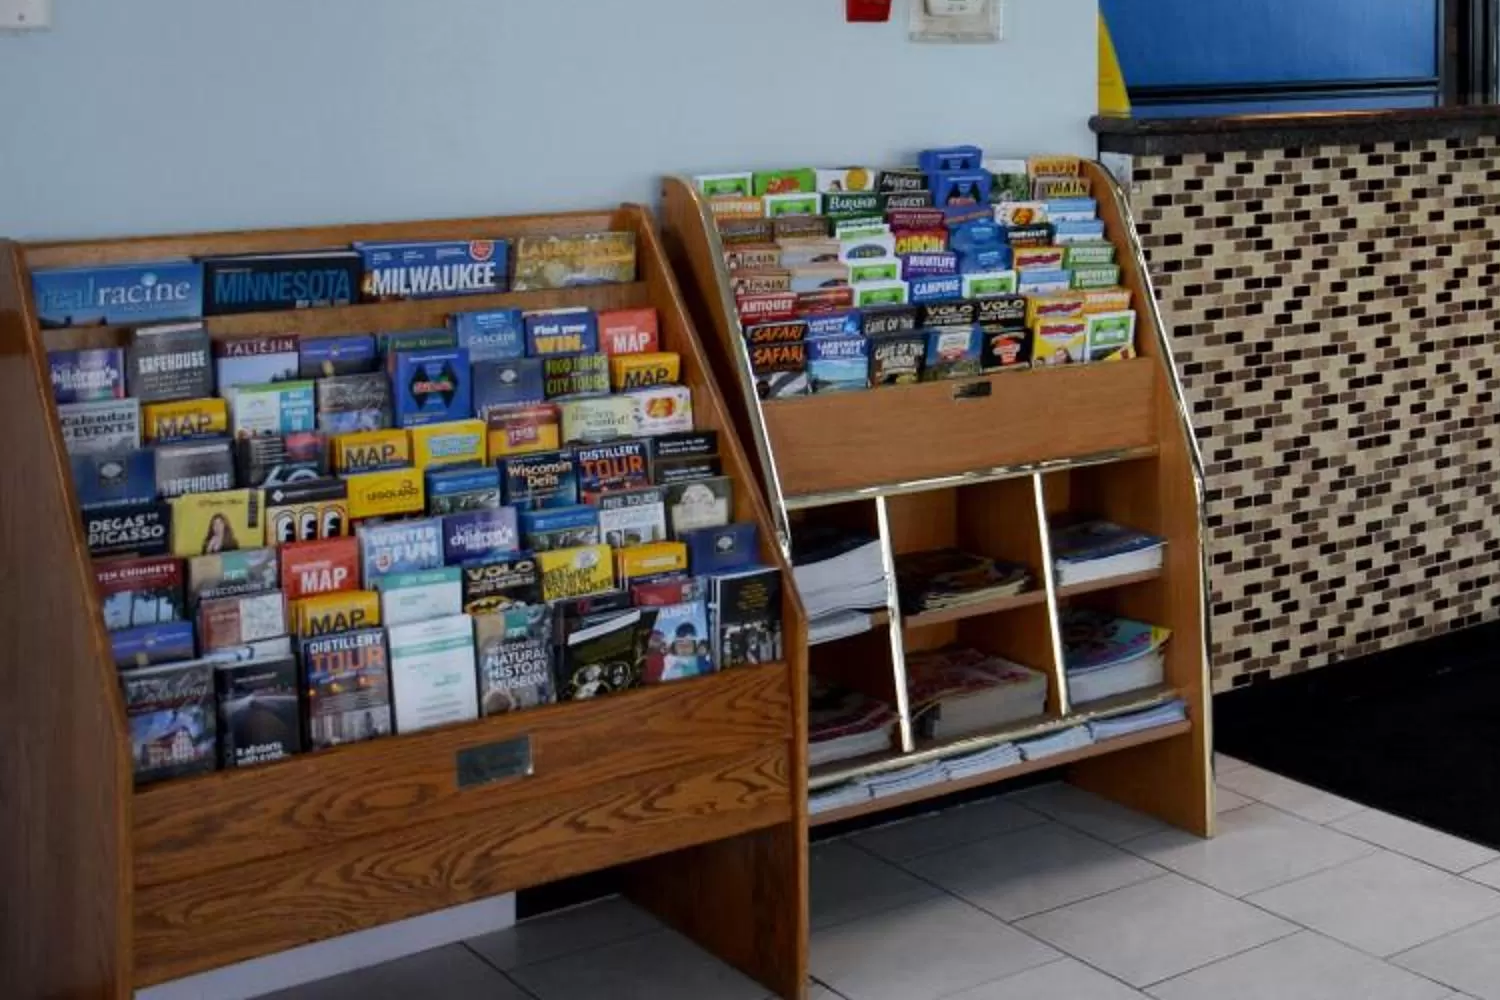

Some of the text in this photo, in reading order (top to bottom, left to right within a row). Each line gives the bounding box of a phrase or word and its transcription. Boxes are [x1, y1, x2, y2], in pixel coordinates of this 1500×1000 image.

[215, 268, 350, 304] MINNESOTA
[371, 262, 497, 297] MILWAUKEE
[913, 279, 961, 296] CAMPING
[979, 299, 1025, 312] VOLO
[612, 332, 651, 353] MAP
[546, 374, 609, 394] CITY TOURS
[624, 366, 670, 388] MAP
[73, 422, 136, 438] EVENTS
[157, 412, 213, 438] MAP
[345, 443, 397, 467] MAP
[579, 443, 641, 461] DISTILLERY
[507, 460, 573, 477] Wisconsin
[582, 456, 645, 481] TOUR
[89, 513, 146, 534] DEGAS
[88, 524, 165, 546] PICASSO
[301, 567, 349, 594] MAP
[467, 560, 535, 582] VOLO
[310, 608, 366, 636] MAP
[310, 631, 384, 655] DISTILLERY
[312, 647, 384, 676] TOUR
[488, 648, 547, 668] NATURAL
[488, 659, 549, 680] HISTORY
[488, 673, 549, 691] MUSEUM
